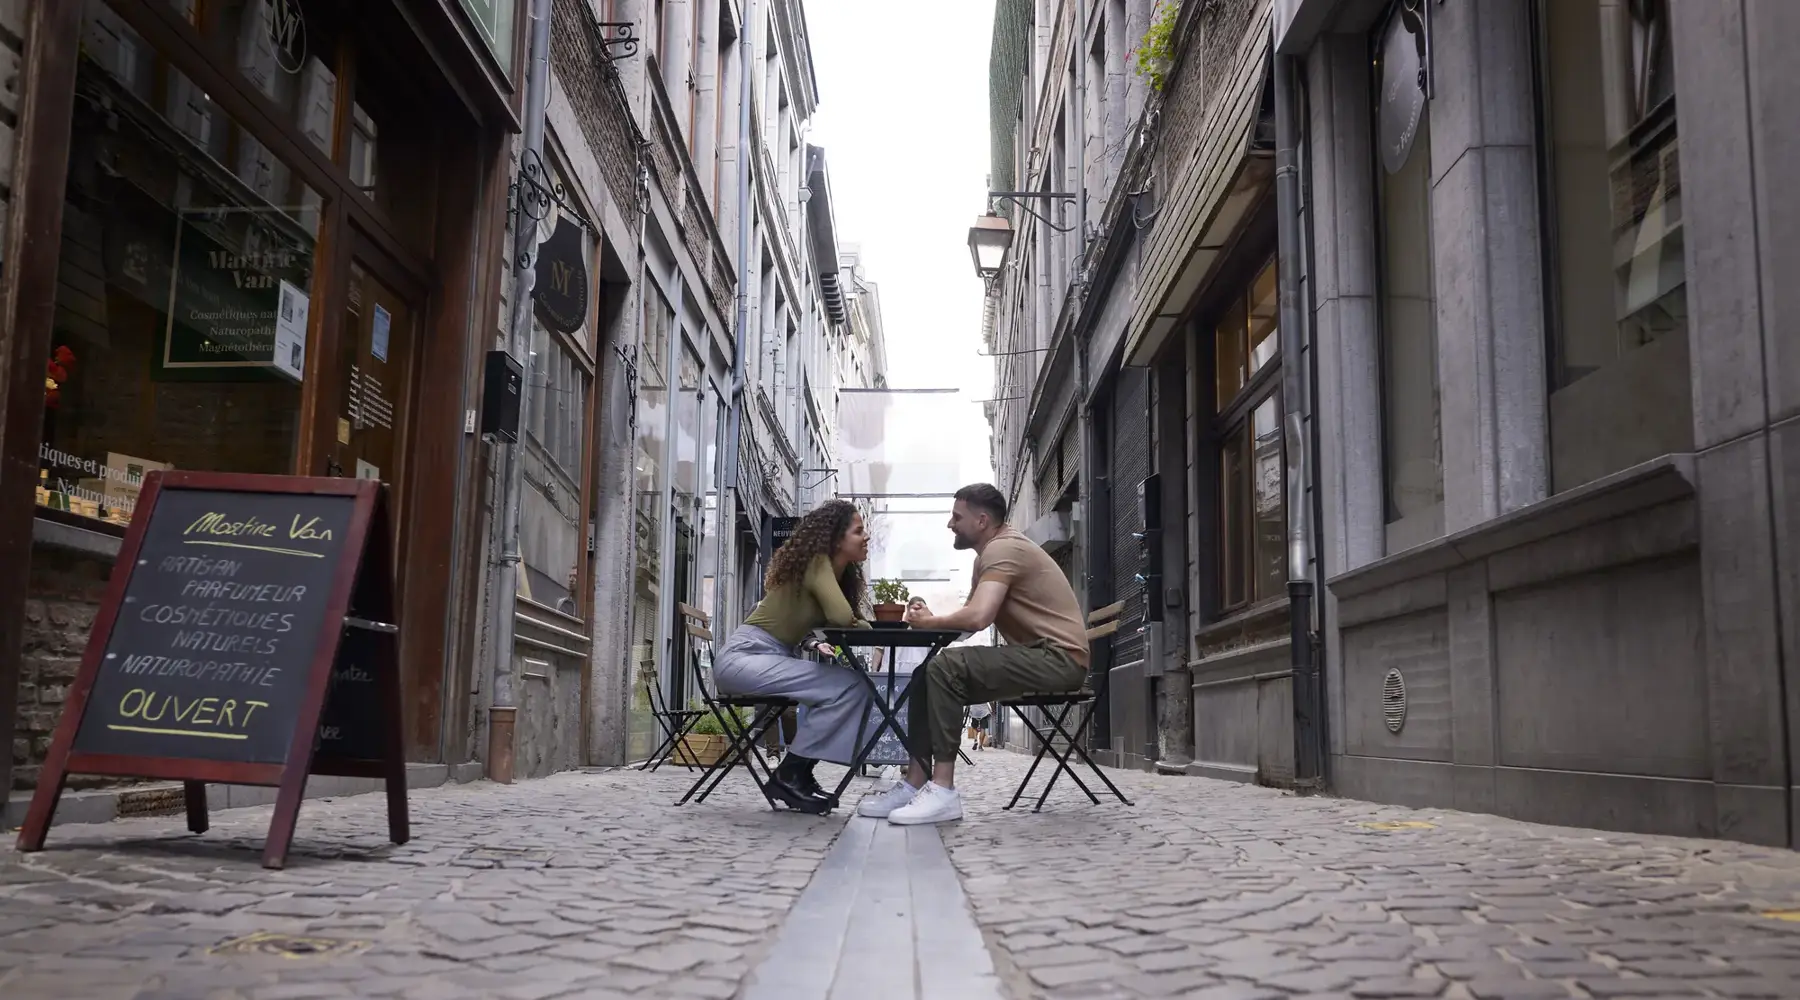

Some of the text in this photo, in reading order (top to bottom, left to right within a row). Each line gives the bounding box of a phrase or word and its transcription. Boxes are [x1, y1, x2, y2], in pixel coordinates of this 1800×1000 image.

[207, 250, 297, 269] Martine
[232, 270, 274, 290] Van
[289, 513, 333, 541] Van
[181, 579, 307, 603] PARFUMEUR
[140, 601, 295, 633] COSMÉTIQUES
[171, 629, 280, 655] NATURELS
[119, 653, 282, 687] NATUROPATHIE
[119, 688, 269, 728] OUVERT
